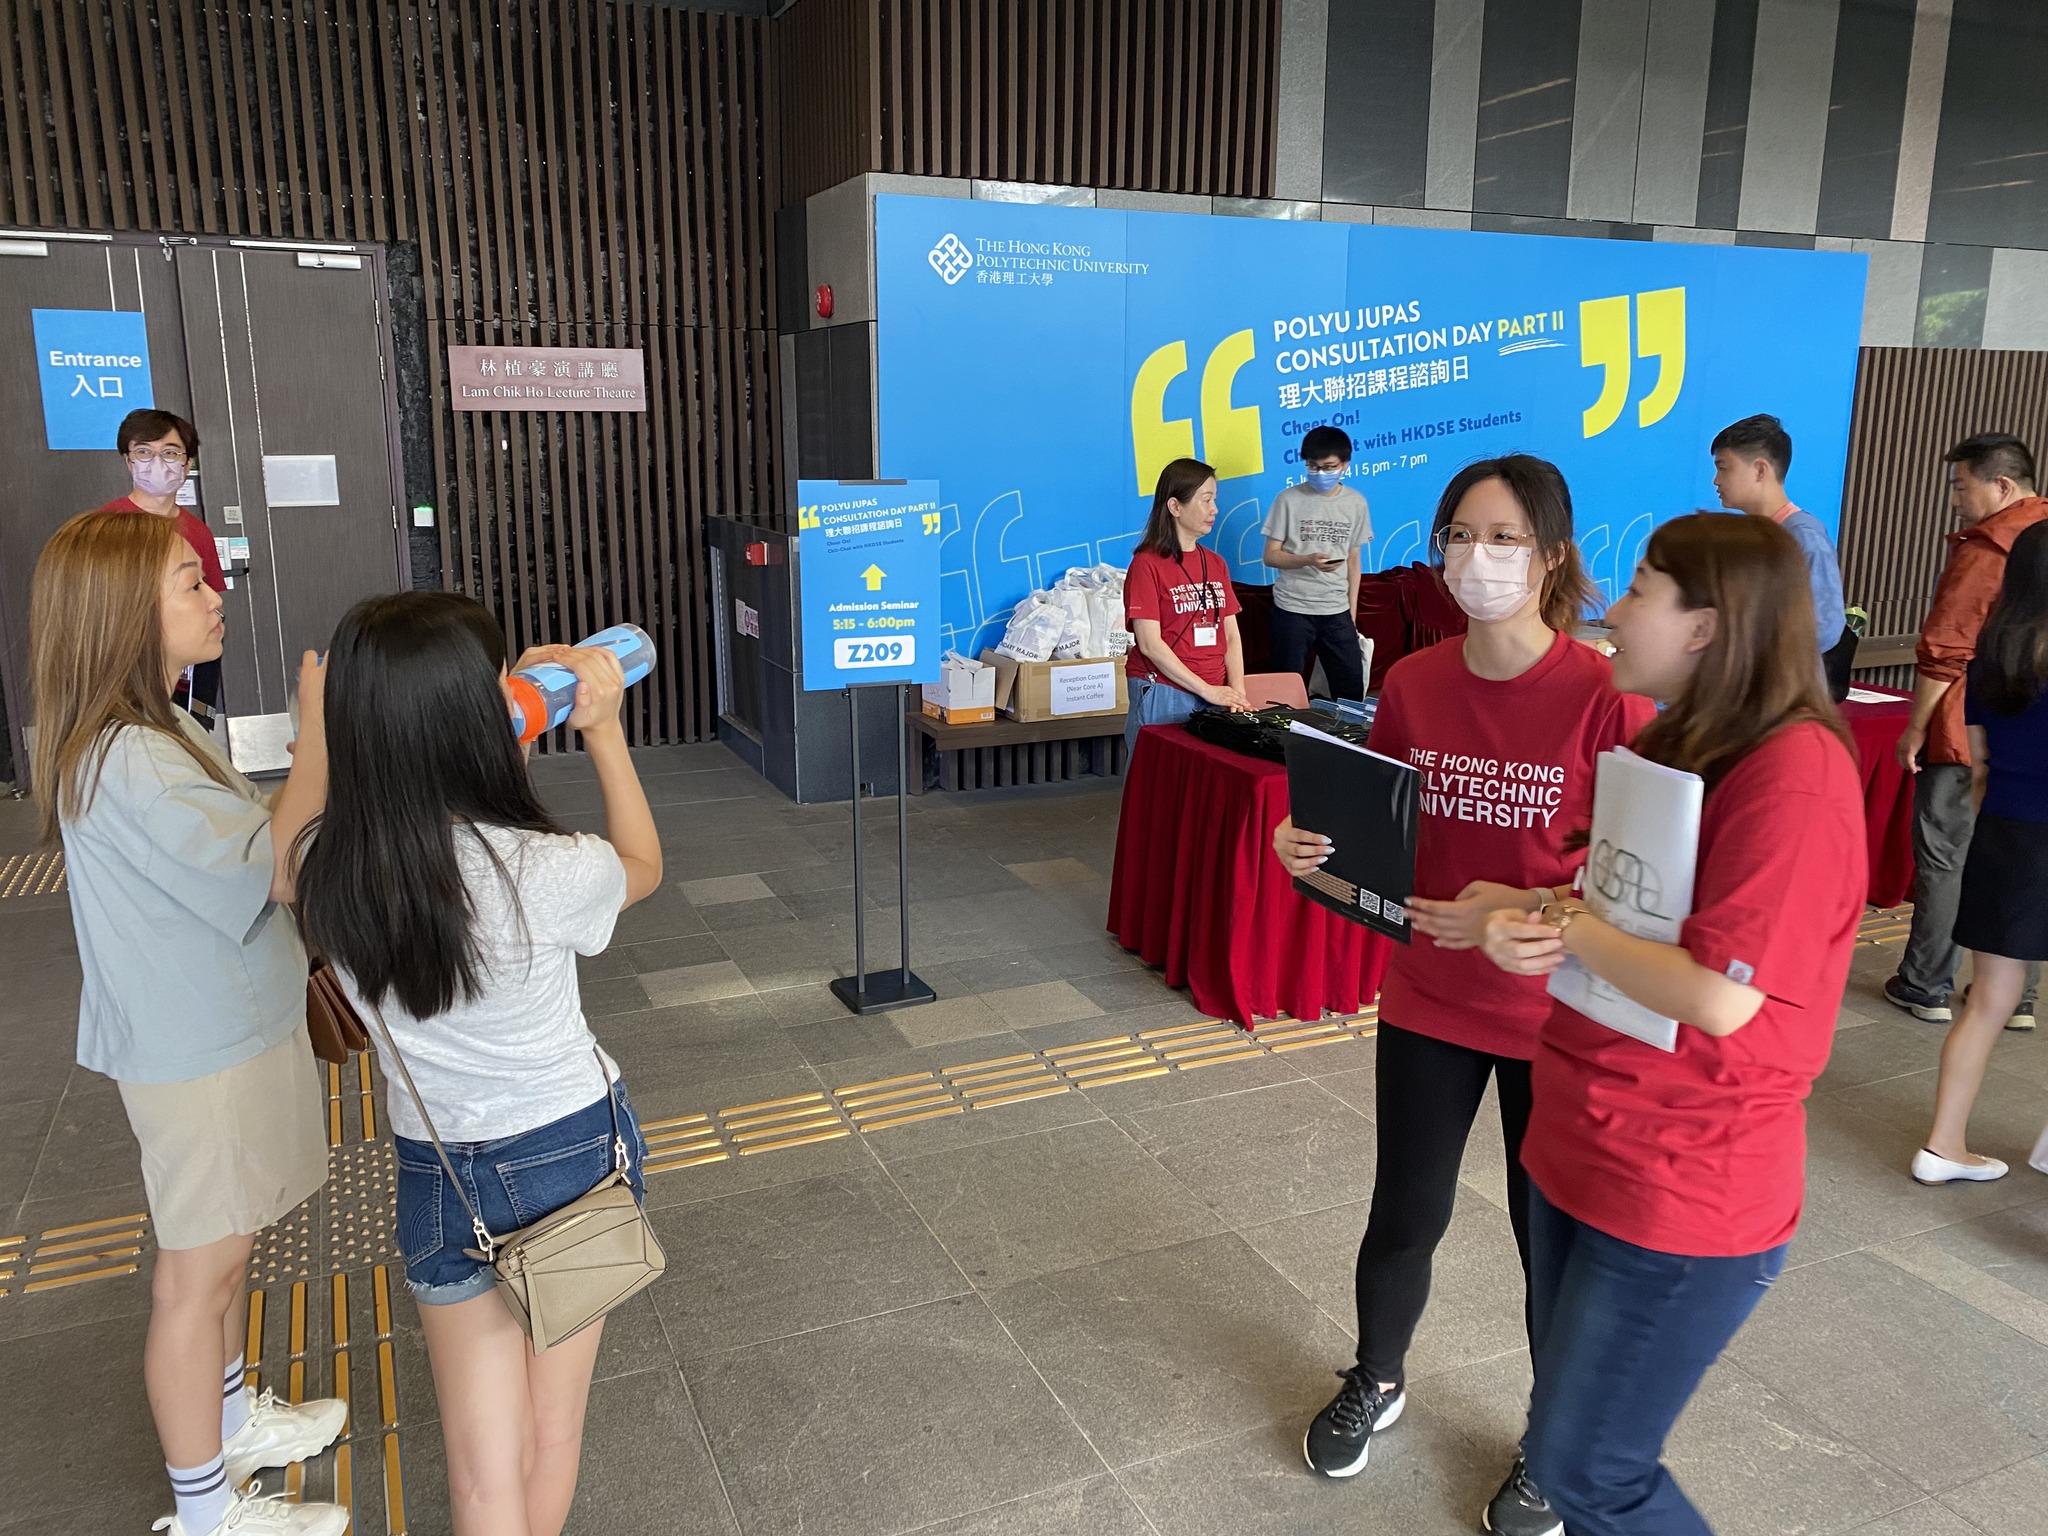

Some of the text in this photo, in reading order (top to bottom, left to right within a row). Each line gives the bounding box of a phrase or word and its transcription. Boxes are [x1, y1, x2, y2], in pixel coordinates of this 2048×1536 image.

[975, 238, 1091, 258] THE HONG KONG
[976, 254, 1149, 275] POLYTECHNIC UNIVERSITY
[976, 270, 1054, 287] 香港理工大學
[1273, 300, 1421, 343] POLYU JUPAS
[1275, 310, 1564, 374] CONSULTATION DAY PART II
[49, 350, 142, 368] Entrance
[479, 358, 620, 379] 林植豪演講廳
[70, 374, 123, 398] 入口
[462, 385, 637, 399] Lam Chik Ho Lecture Theatre
[1278, 355, 1469, 410] 理大聯招課程諮詢日
[1332, 409, 1360, 427] On!
[1364, 410, 1522, 450] with HKDSE Students
[1362, 464, 1370, 475] 5
[1372, 461, 1390, 476] pm
[1400, 455, 1408, 468] 7
[1410, 453, 1428, 469] pm
[821, 498, 878, 513] POLYU JUPAS
[823, 502, 936, 525] CONSULTATION DAY PART II
[1169, 584, 1187, 596] THE
[828, 600, 919, 612] Admission Seminar
[833, 618, 856, 630] 5:15
[867, 616, 915, 630] 6:00pm
[847, 642, 903, 663] Z209
[1016, 647, 1039, 659] MAJOR
[1059, 639, 1081, 651] MAJOR
[1060, 673, 1110, 684] Reception Counter
[1066, 685, 1082, 693] (Near
[1083, 683, 1097, 691] Core
[1066, 694, 1086, 702] Instant
[1409, 747, 1565, 784] THE HONG KONG
[1419, 791, 1560, 829] NIVERSITY
